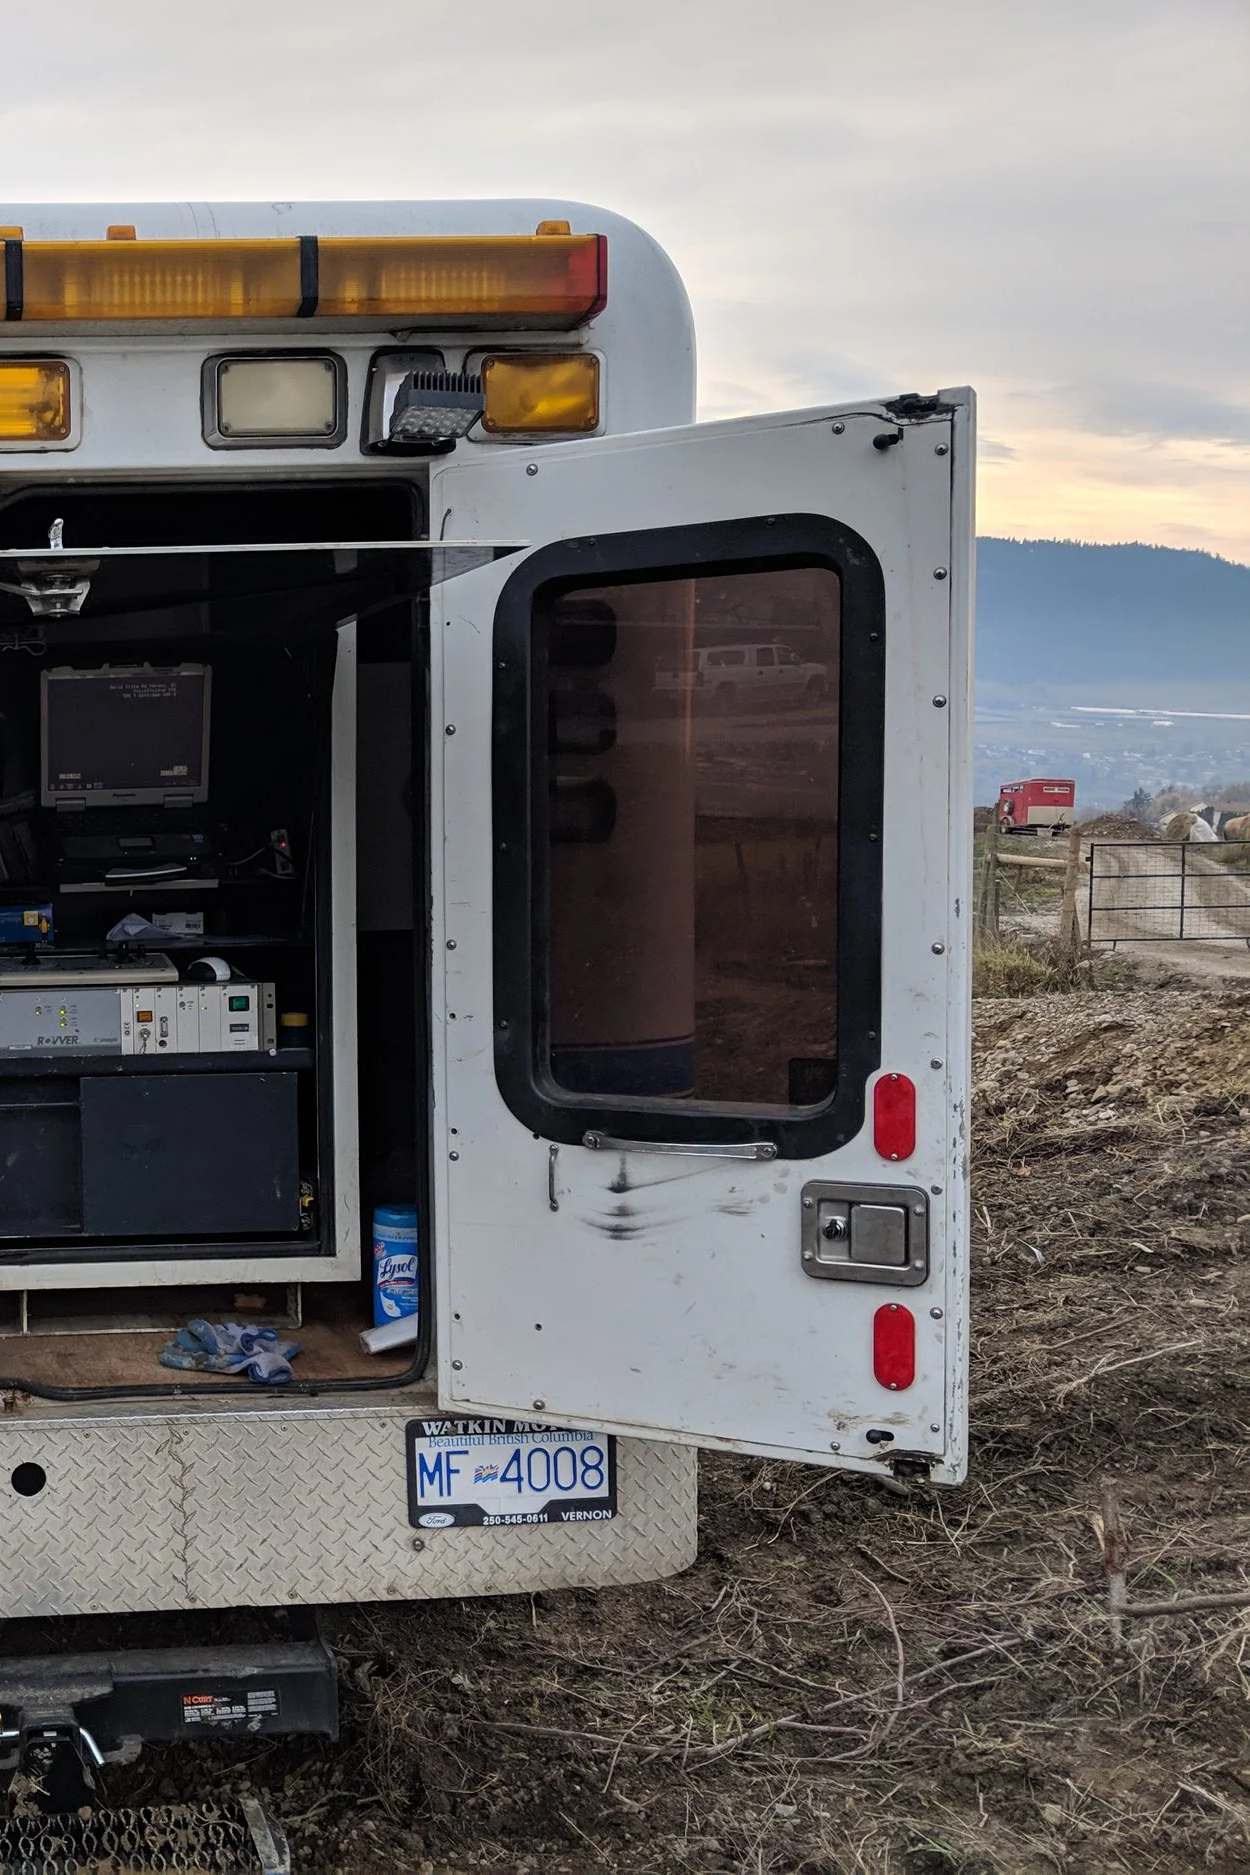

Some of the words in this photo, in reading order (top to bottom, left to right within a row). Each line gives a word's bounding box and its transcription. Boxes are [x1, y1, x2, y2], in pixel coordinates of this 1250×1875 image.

[380, 1256, 415, 1279] Lysol
[422, 1419, 506, 1436] WATKIN
[429, 1433, 485, 1448] Beautiful
[489, 1432, 529, 1446] British
[532, 1430, 594, 1444] Columbia
[418, 1450, 469, 1498] MF
[499, 1446, 604, 1494] 4008
[426, 1515, 447, 1525] Ford
[483, 1513, 548, 1526] 250-545-0611
[561, 1510, 612, 1522] VERNON
[192, 1695, 214, 1704] CURT
